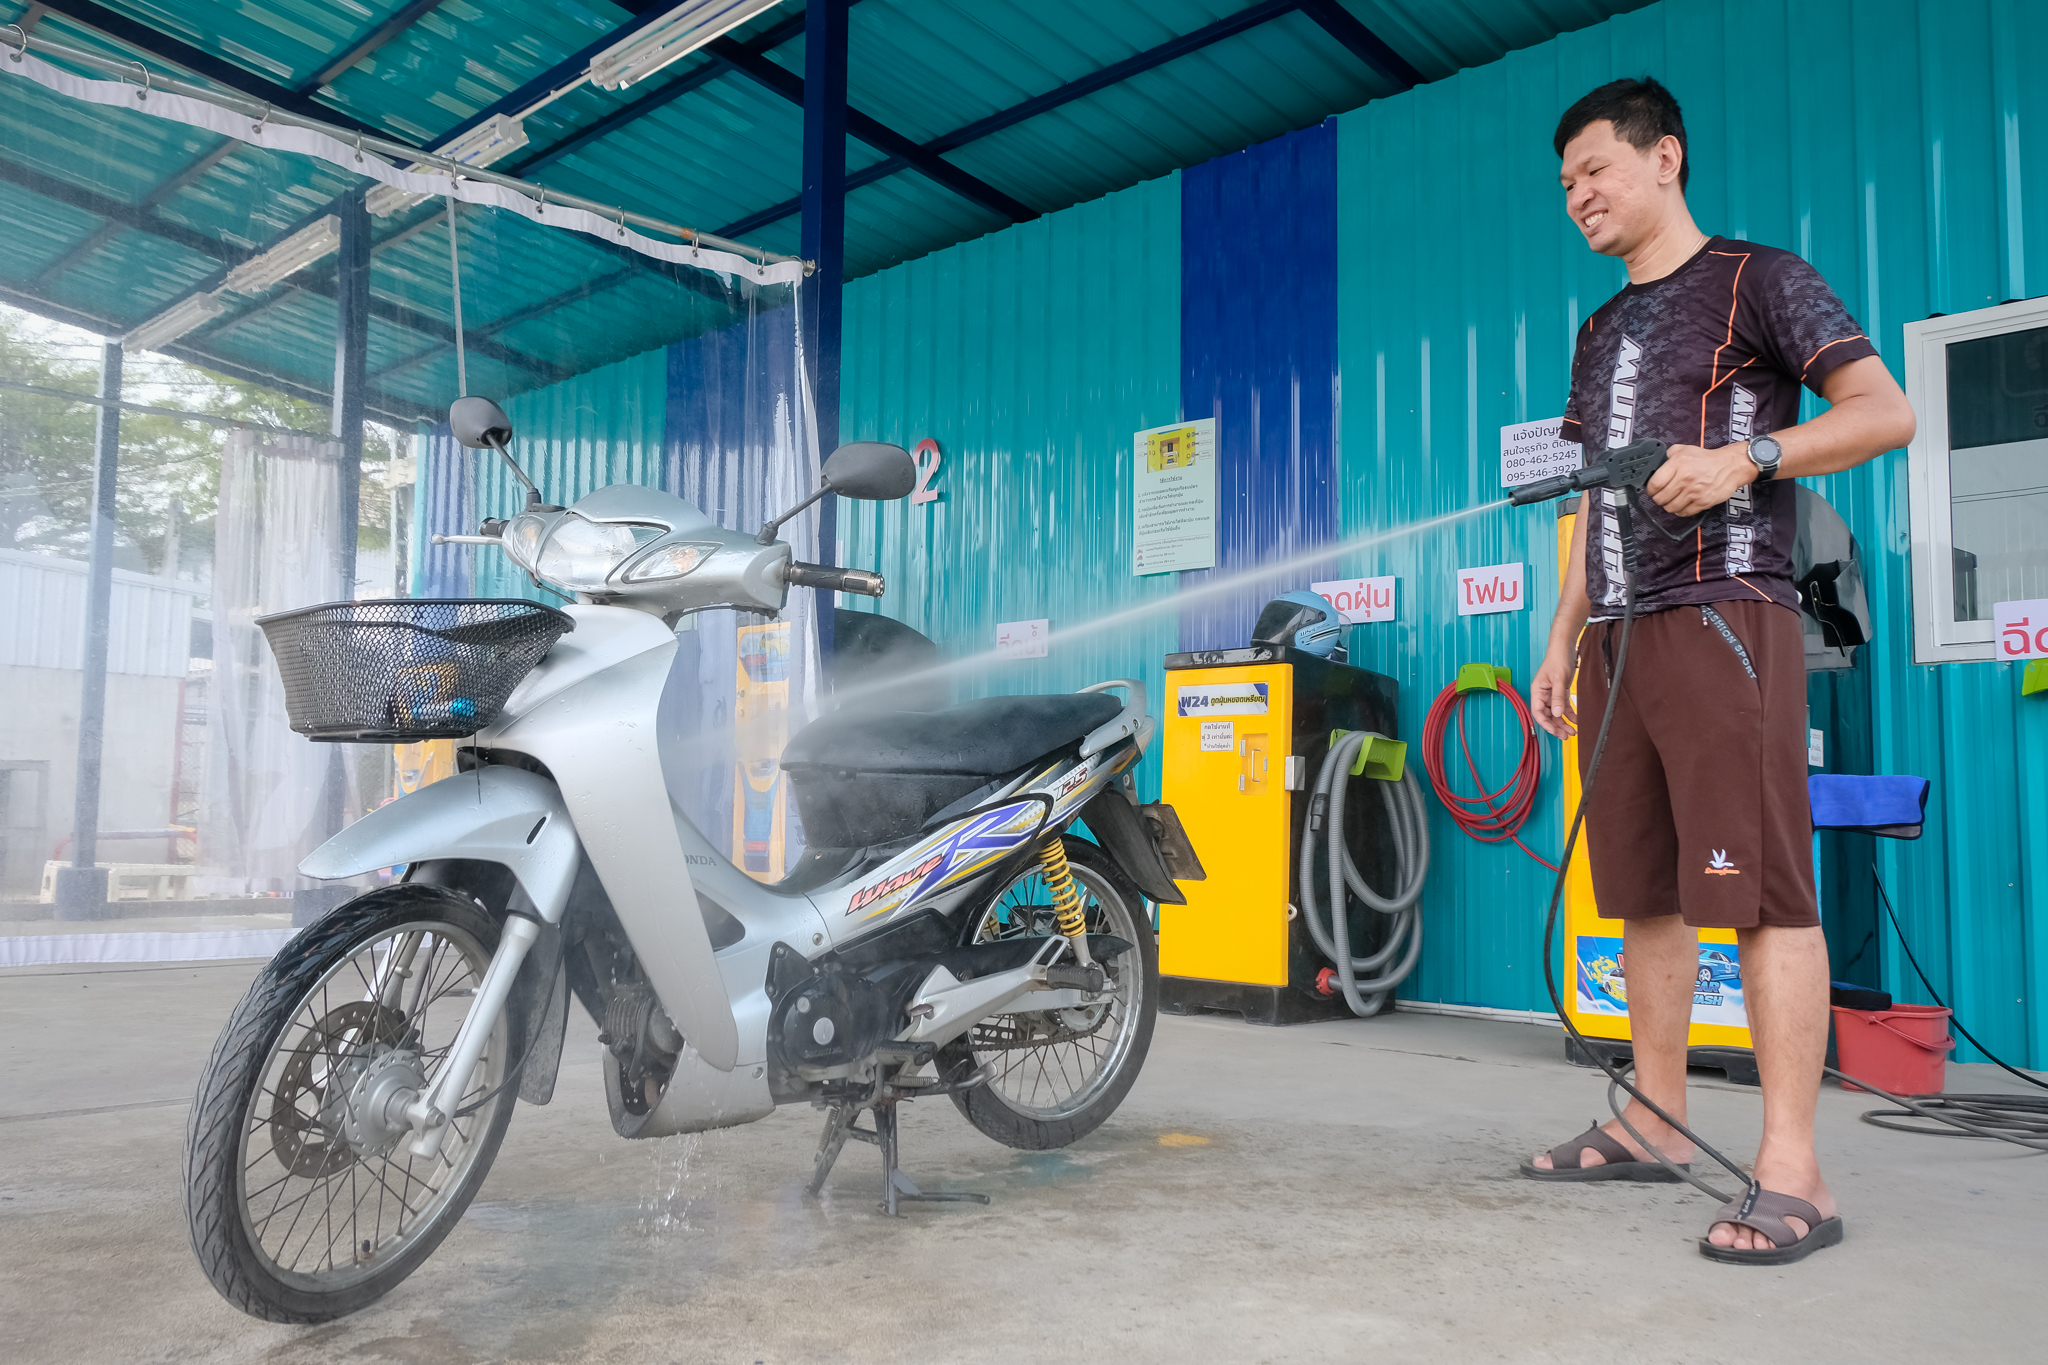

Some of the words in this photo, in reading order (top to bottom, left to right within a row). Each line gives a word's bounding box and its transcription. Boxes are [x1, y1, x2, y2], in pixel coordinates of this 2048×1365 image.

[1607, 334, 1643, 449] MUA
[1513, 425, 1563, 441] แจ้งปัญห
[1503, 441, 1548, 457] สนใจธุรกิจ
[1506, 449, 1577, 469] 080-462-5245
[912, 438, 940, 505] 2
[1506, 463, 1577, 482] 095-546-3922
[1320, 582, 1390, 618] ดฝุ่น
[1462, 576, 1518, 606] โฟม
[1704, 607, 1737, 644] FASHION
[1734, 644, 1758, 679] SPORT
[1181, 696, 1209, 708] W24
[845, 854, 946, 916] Wave
